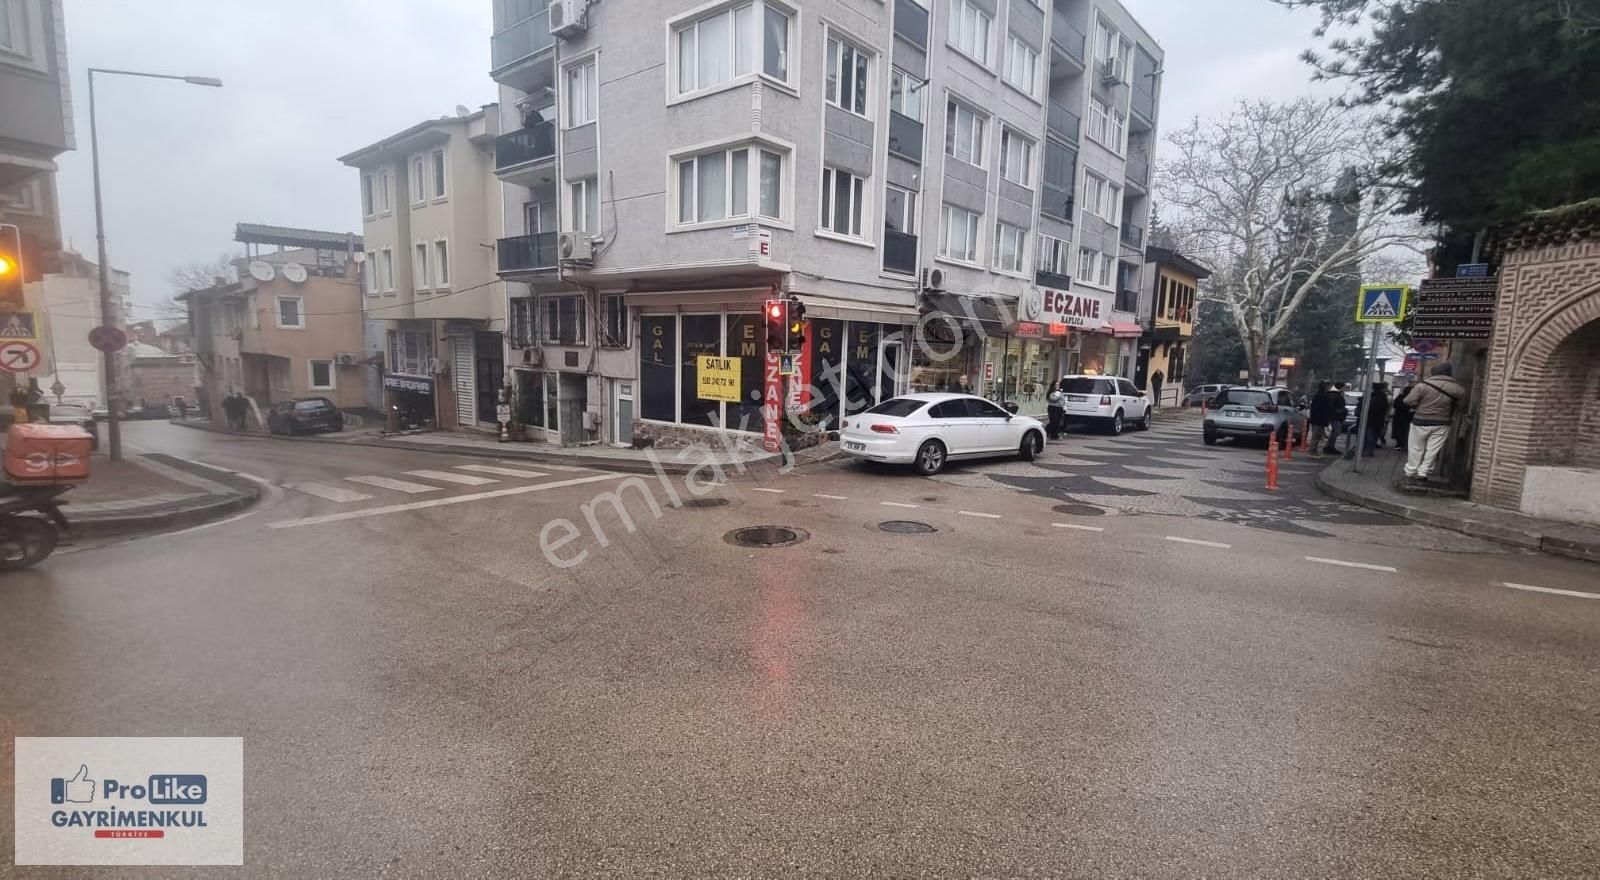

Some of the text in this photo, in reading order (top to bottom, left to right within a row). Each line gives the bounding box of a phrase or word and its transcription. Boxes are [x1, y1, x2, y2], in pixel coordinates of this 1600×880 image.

[760, 242, 769, 256] E
[1044, 289, 1100, 319] ECZANE
[1061, 315, 1084, 325] KAPLICA
[820, 328, 832, 353] GA
[706, 358, 731, 371] SATILIK
[985, 363, 992, 379] E
[789, 353, 804, 406] ZANE
[766, 353, 779, 439] CZANE
